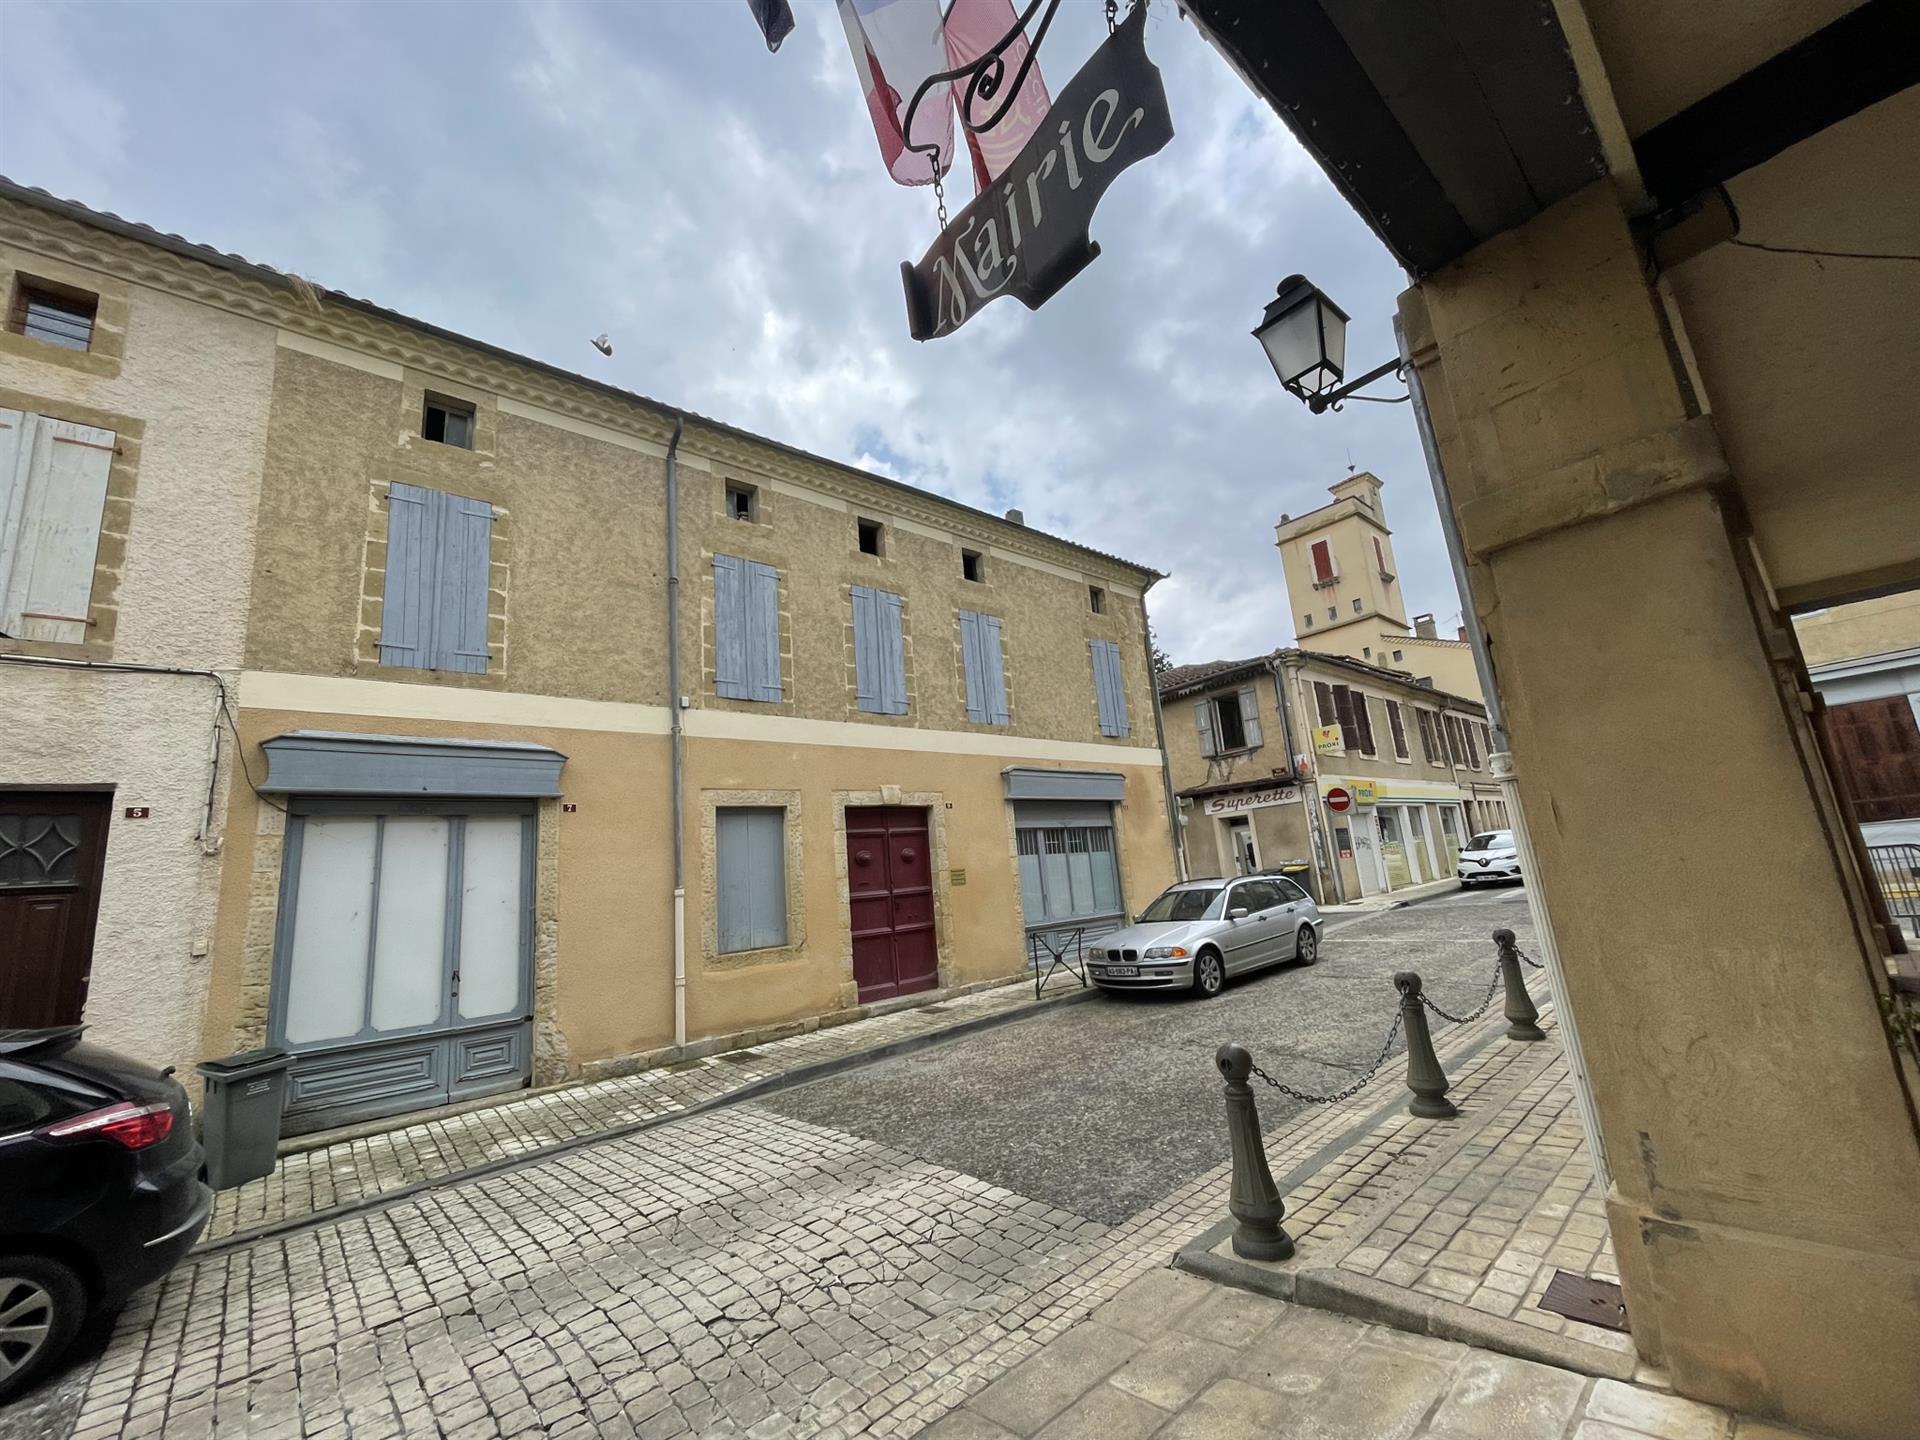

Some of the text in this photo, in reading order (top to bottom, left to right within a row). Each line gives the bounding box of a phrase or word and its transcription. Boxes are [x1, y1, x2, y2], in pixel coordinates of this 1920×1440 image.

[932, 88, 1144, 335] Mairie
[133, 808, 142, 818] 5
[1211, 789, 1296, 813] Superette
